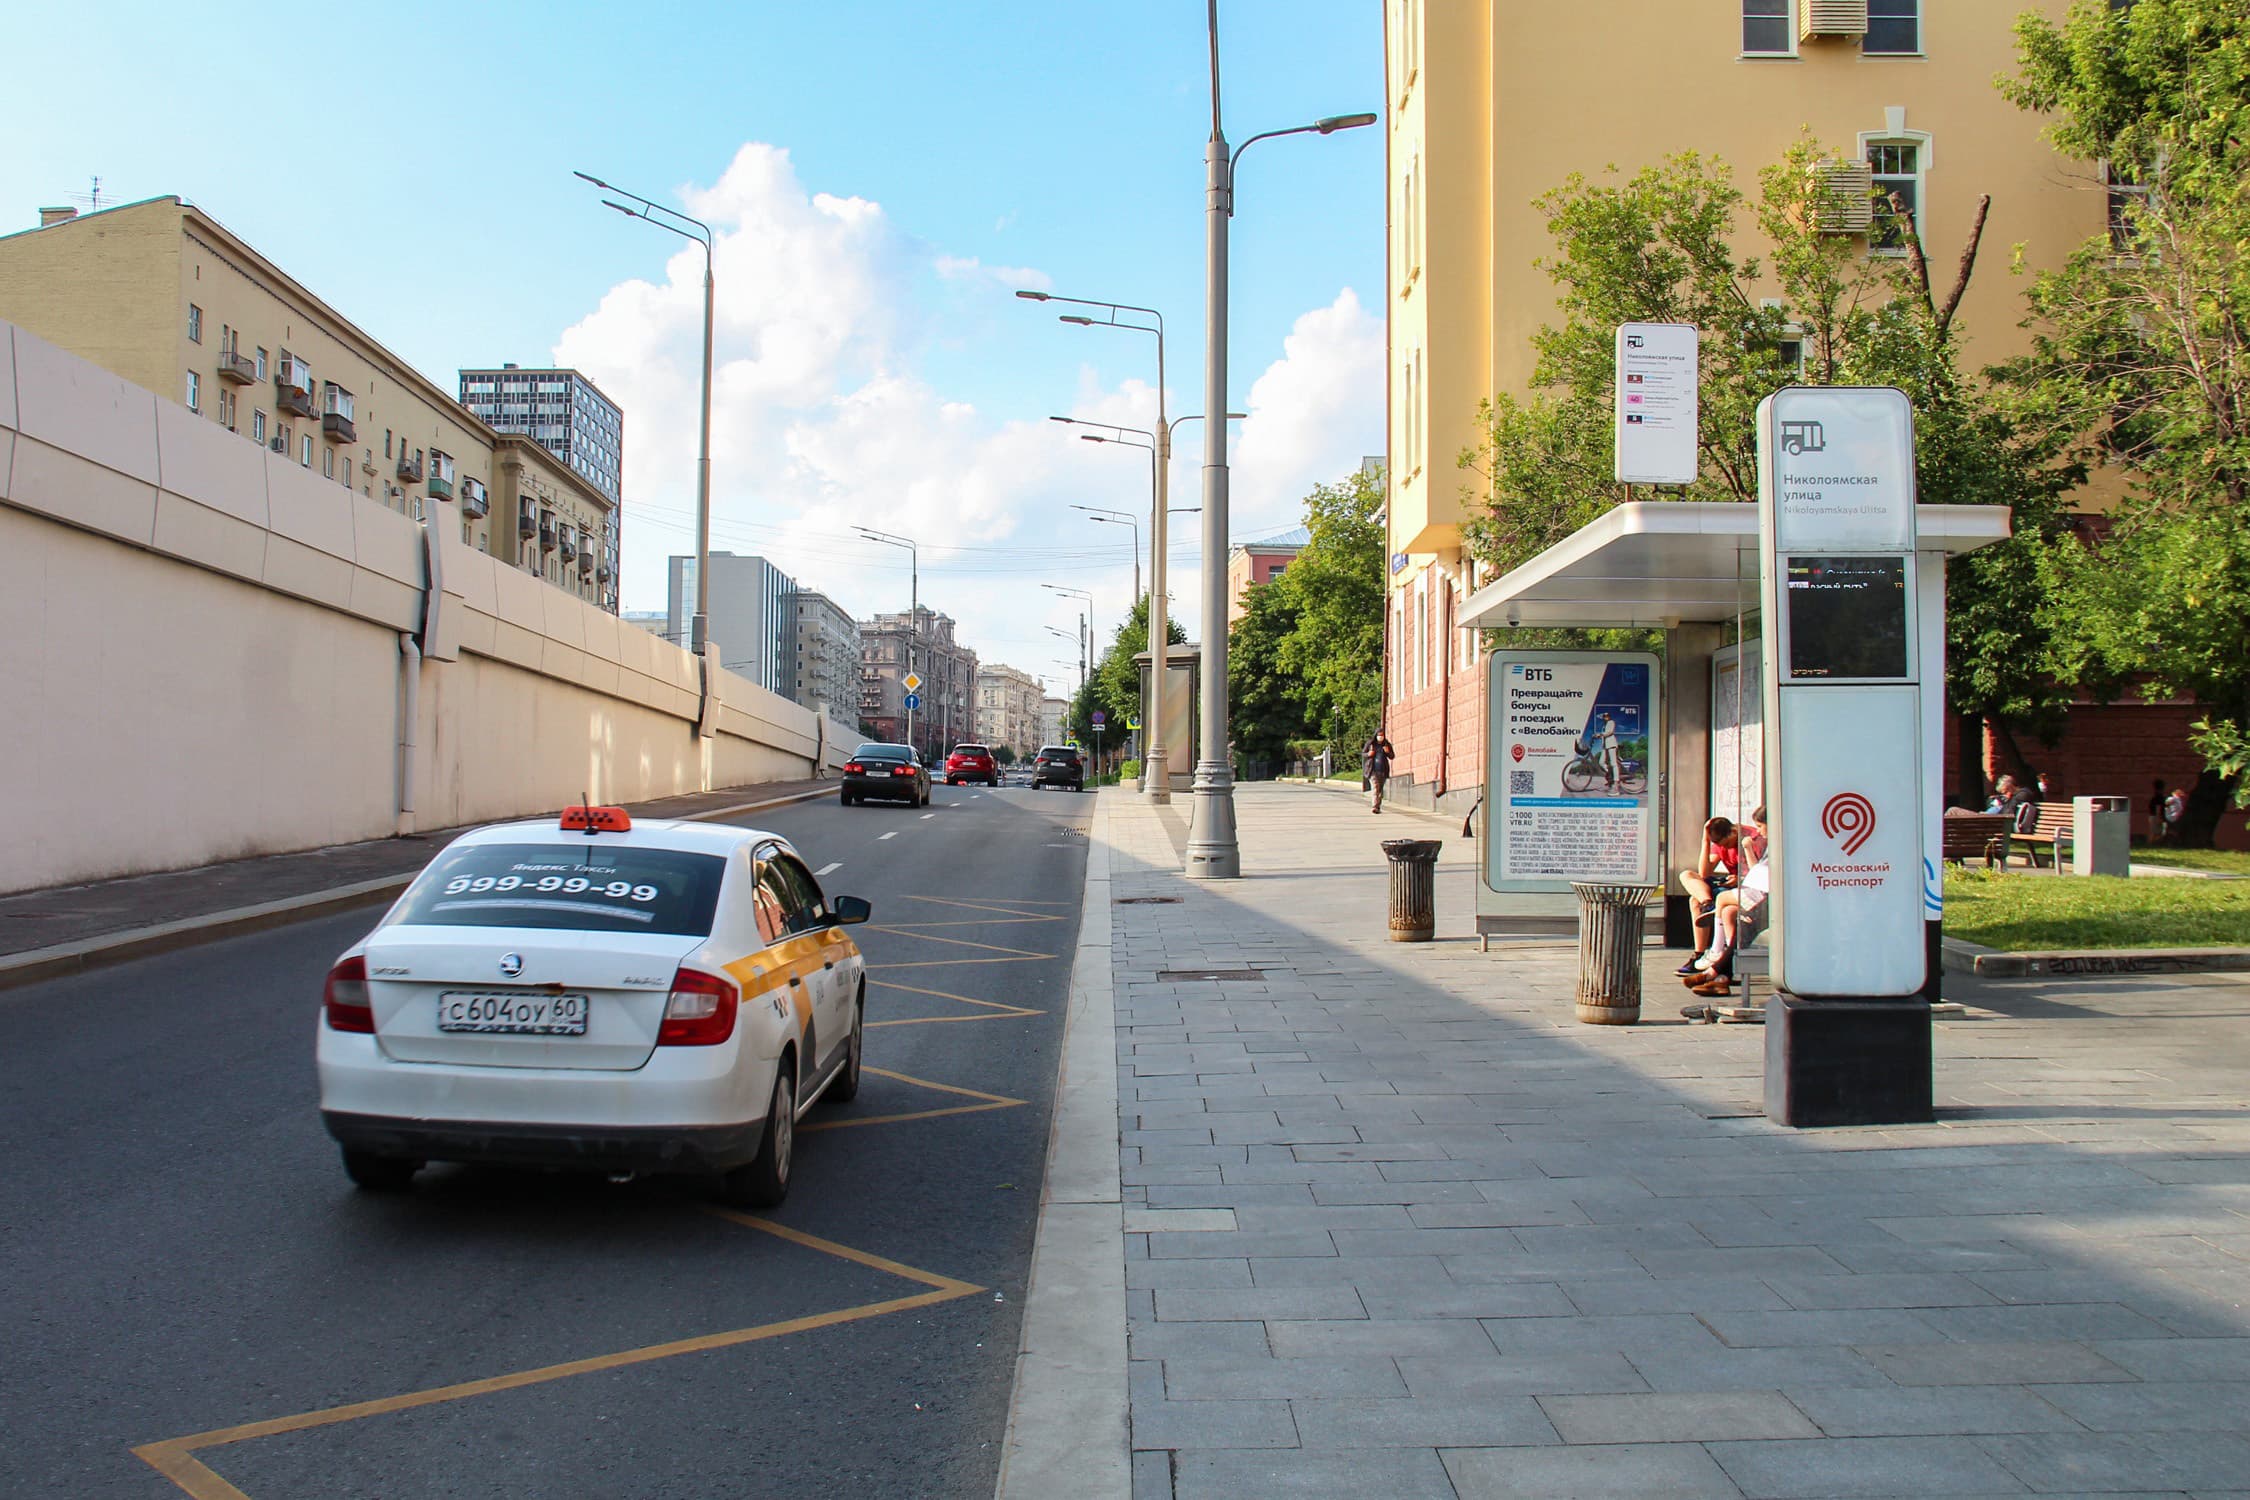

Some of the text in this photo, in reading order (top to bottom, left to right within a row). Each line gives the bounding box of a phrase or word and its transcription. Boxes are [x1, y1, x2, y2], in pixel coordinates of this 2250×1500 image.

[1783, 474, 1878, 485] Николоямская
[1783, 491, 1822, 502] улица
[1784, 505, 1887, 516] Nikoloyamskaya Ulitsa
[1525, 668, 1552, 681] ВТБ
[1511, 688, 1584, 700] Превращайте
[1511, 701, 1551, 712] бонусы
[1519, 715, 1564, 723] поездки
[1518, 726, 1581, 736] «Велобайк»
[1515, 811, 1532, 819] 1000
[510, 862, 616, 875] Яндекс Такси
[1810, 862, 1890, 873] Московский
[443, 875, 659, 902] 999-99-99
[1816, 876, 1884, 890] Транспорт
[553, 999, 577, 1017] 60
